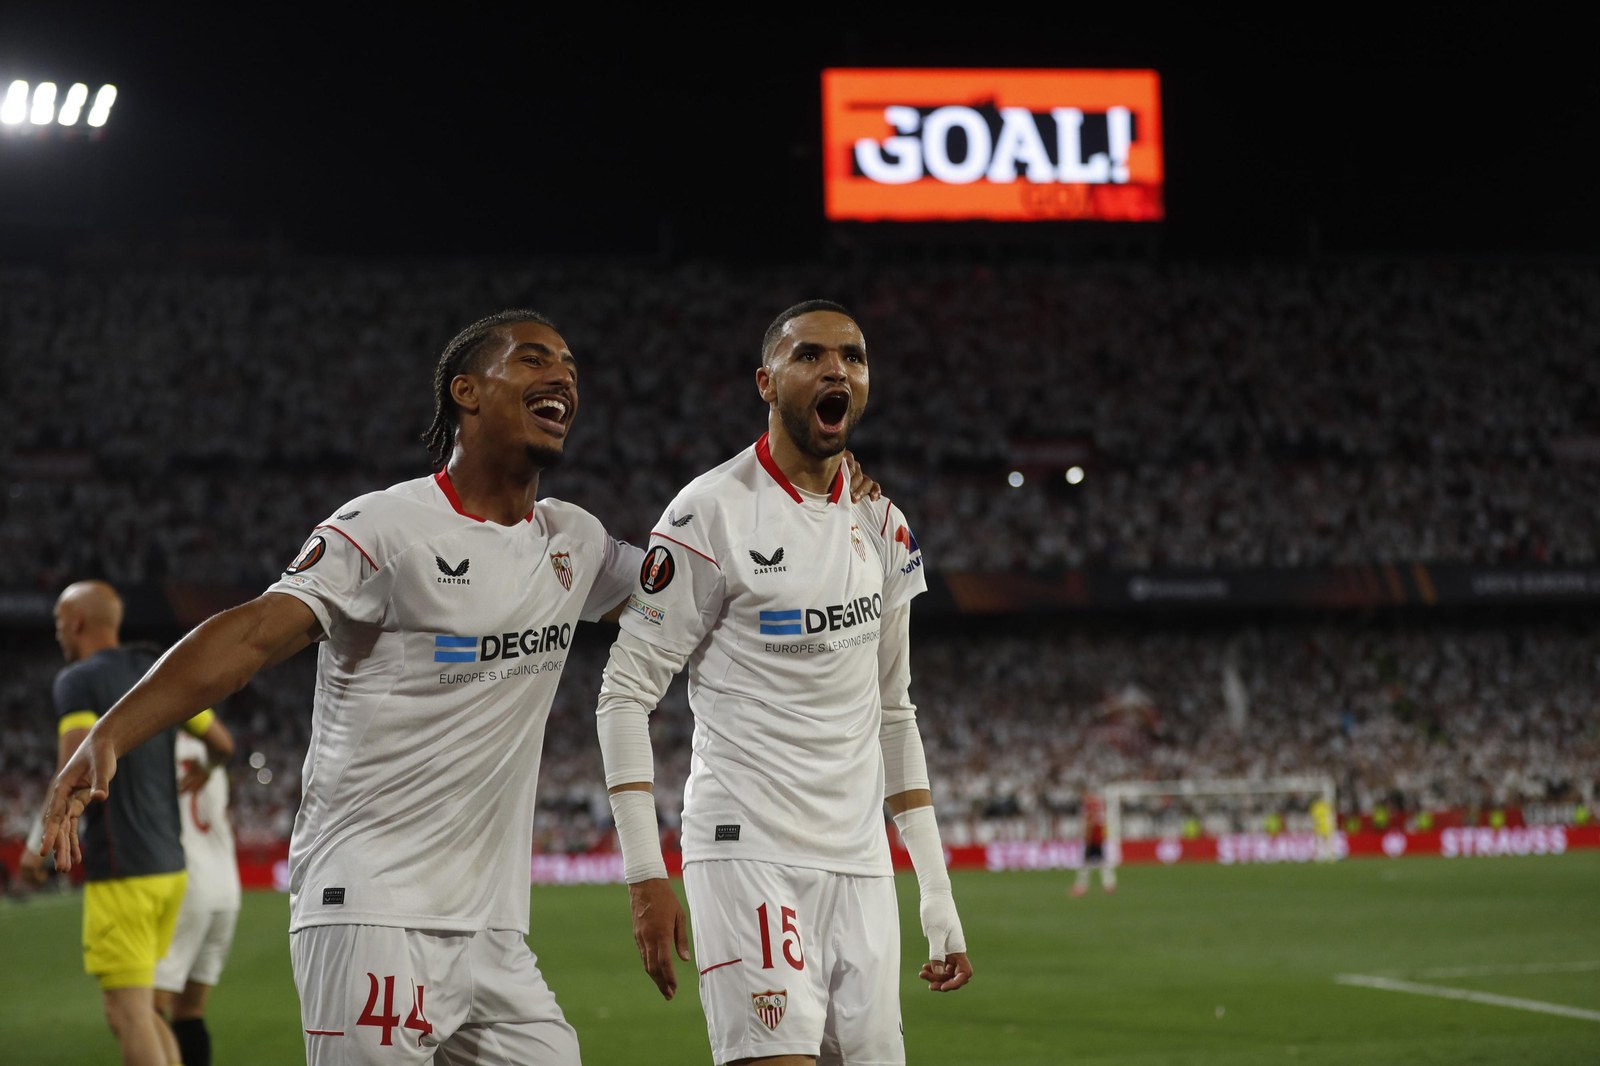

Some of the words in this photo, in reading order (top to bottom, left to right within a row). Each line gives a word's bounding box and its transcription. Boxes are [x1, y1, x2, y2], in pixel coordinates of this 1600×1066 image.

[854, 105, 1132, 184] GOAL!
[437, 577, 471, 585] CASTORE
[650, 563, 659, 578] 6
[753, 566, 787, 575] CASTORE
[805, 593, 882, 634] DEGIRO
[480, 622, 571, 662] DEGIRO
[828, 636, 860, 652] LEADING
[500, 664, 539, 680] LEDING
[1216, 831, 1349, 866] STRAUS
[1440, 825, 1568, 858] STRAUSS
[756, 901, 805, 971] 15
[356, 972, 433, 1047] 44
